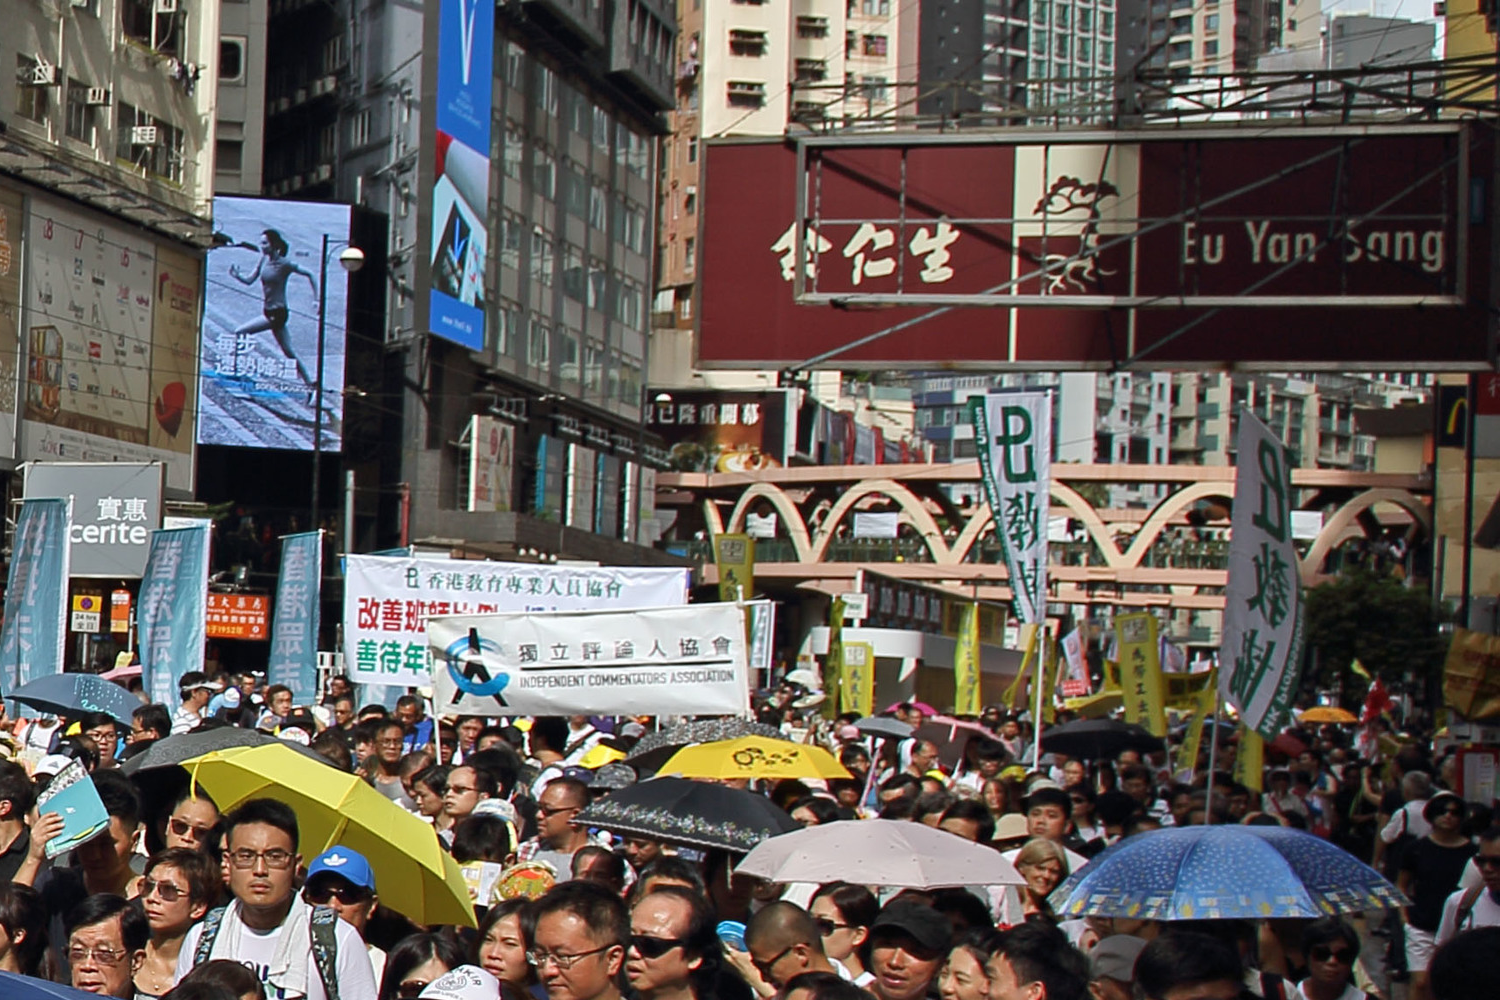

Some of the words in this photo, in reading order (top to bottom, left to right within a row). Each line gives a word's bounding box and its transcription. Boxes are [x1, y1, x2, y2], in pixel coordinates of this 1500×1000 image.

[1247, 220, 1317, 264] Yan
[97, 496, 148, 521] 實惠
[70, 523, 147, 544] cerite
[426, 570, 622, 598] 香港教育專業人員協會
[356, 638, 433, 676] 善待年
[518, 636, 732, 662] 獨立評論人協會
[520, 674, 585, 688] INDEPENDENT
[588, 672, 667, 687] COMMENTATORS
[670, 669, 735, 684] ASSOCIATION
